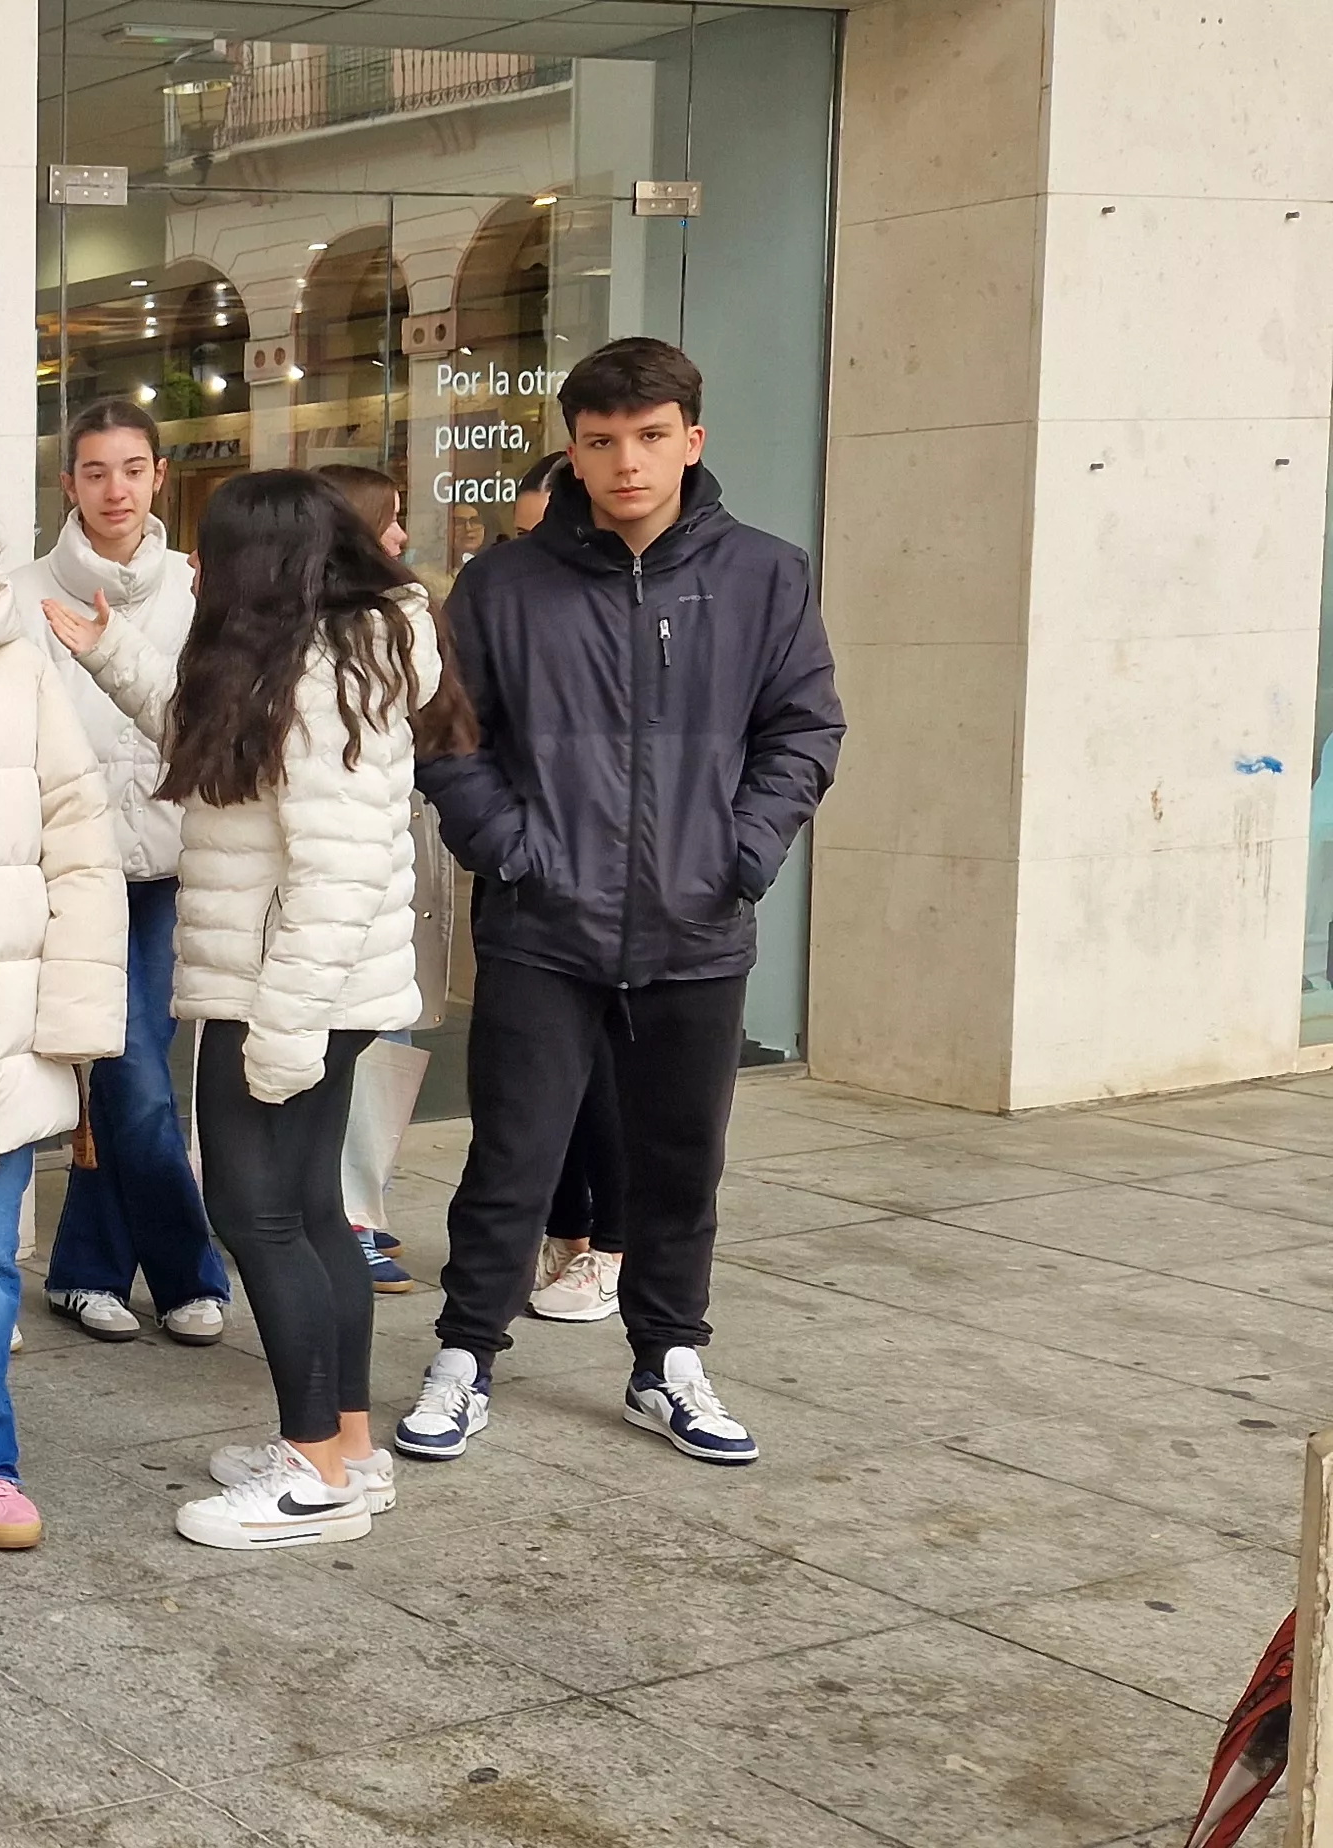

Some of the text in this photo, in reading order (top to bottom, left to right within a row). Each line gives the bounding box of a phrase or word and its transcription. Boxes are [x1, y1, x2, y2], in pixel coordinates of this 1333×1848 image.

[437, 364, 481, 396] Por
[489, 361, 510, 395] la
[435, 420, 530, 458] puerta,
[433, 470, 523, 504] Gracia
